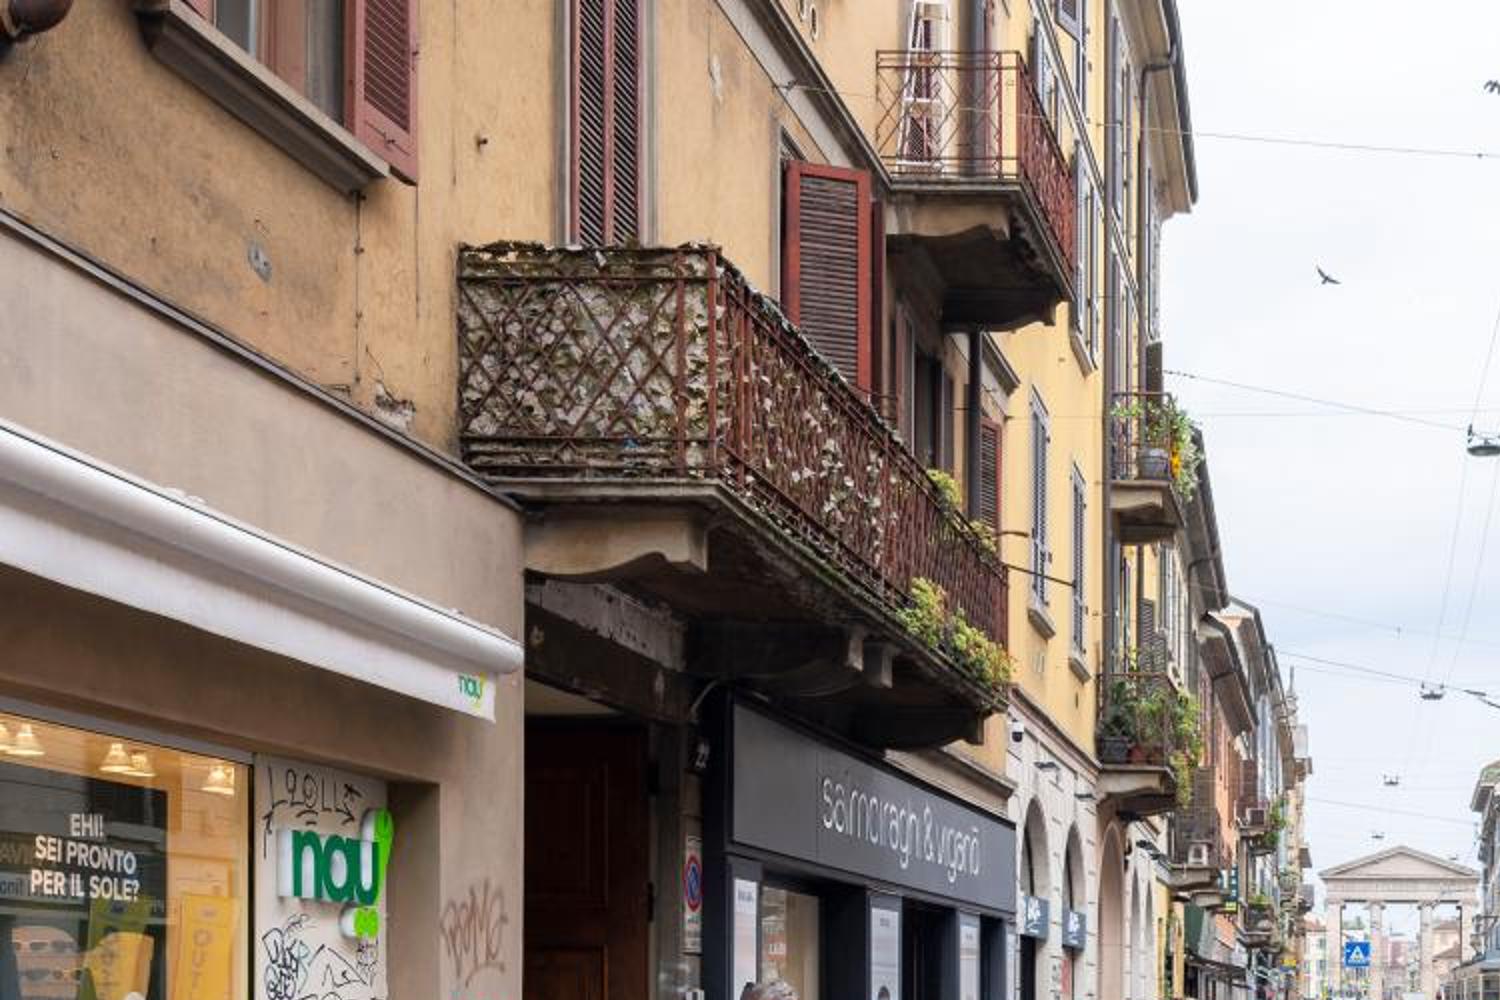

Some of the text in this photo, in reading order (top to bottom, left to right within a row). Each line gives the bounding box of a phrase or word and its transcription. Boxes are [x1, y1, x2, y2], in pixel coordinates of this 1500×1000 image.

[70, 813, 104, 837] EHI!
[923, 805, 934, 861] &
[35, 835, 62, 862] SEI
[66, 841, 137, 875] PRONTO
[31, 869, 66, 896] PER
[70, 873, 85, 897] IL
[89, 876, 140, 902] SOLE?
